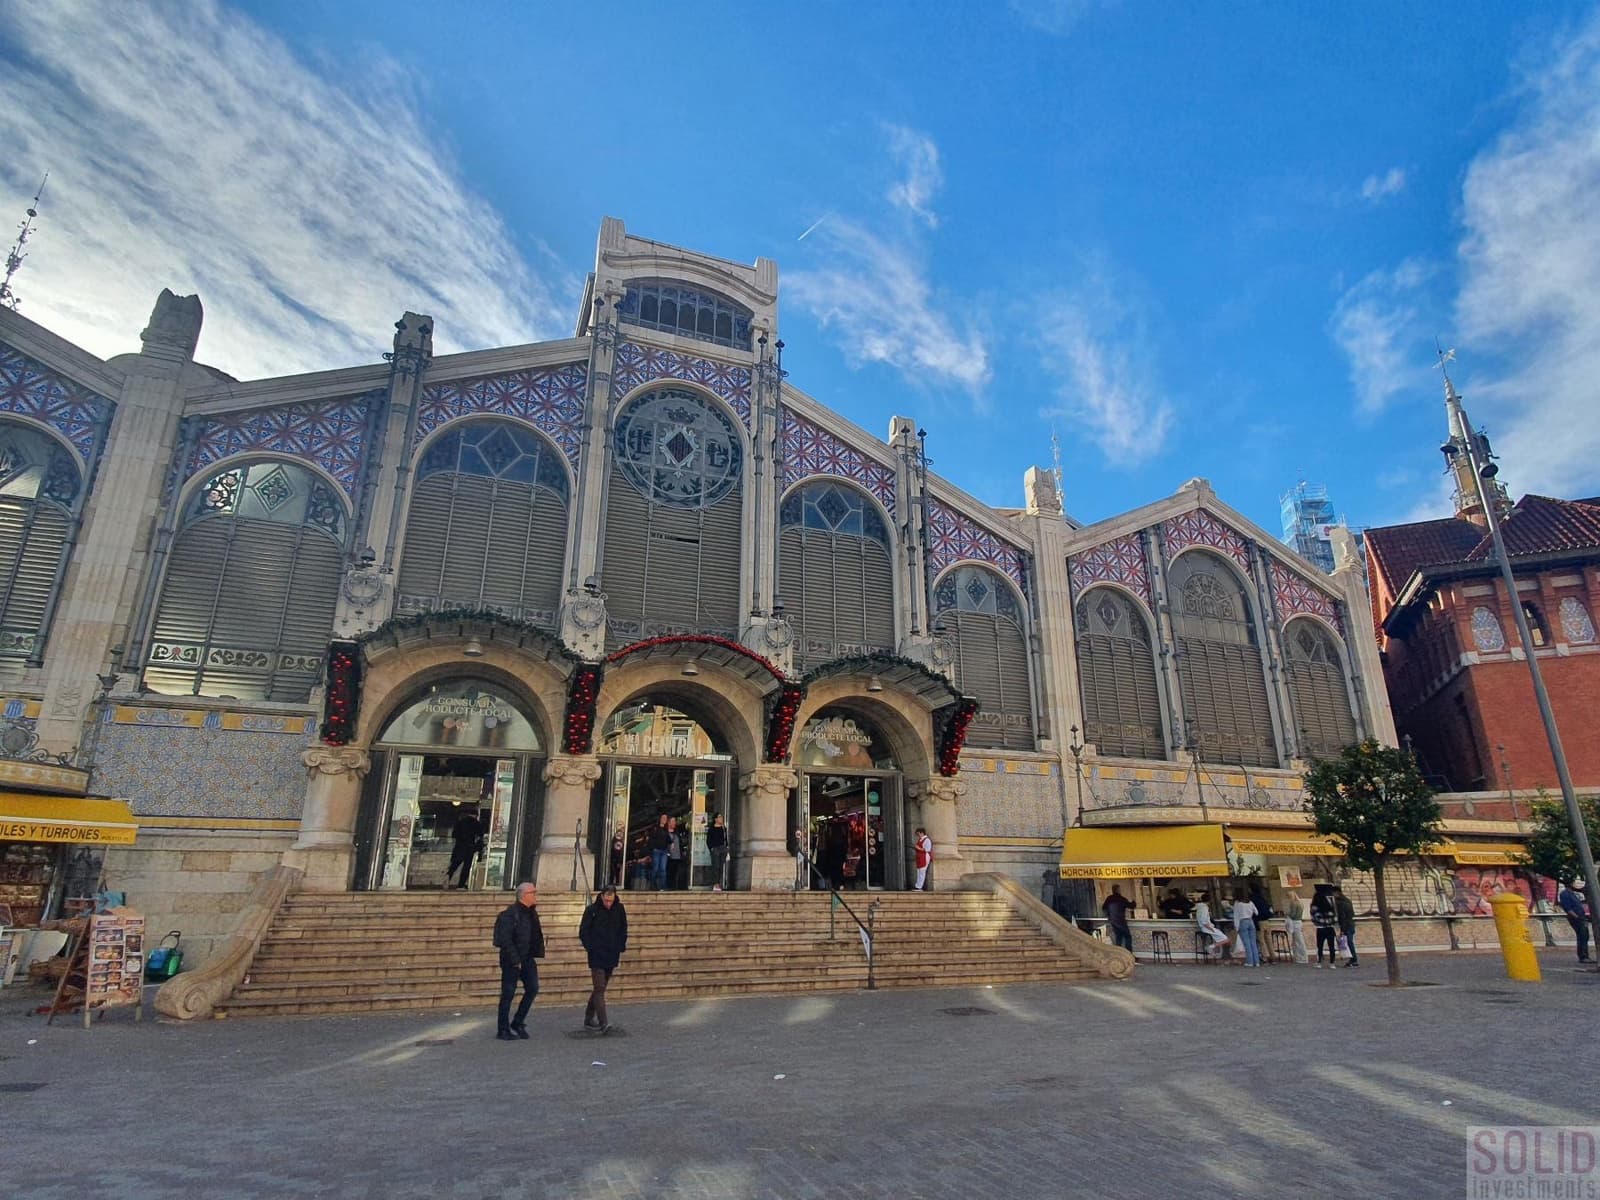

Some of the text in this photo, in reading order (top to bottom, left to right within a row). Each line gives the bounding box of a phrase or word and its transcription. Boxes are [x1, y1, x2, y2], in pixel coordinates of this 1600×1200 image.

[846, 733, 873, 744] LOCAL
[0, 823, 26, 837] ILES
[30, 826, 37, 837] Y
[40, 826, 100, 840] TURRONES
[1061, 866, 1103, 876] HORCHATA
[1105, 866, 1144, 876] CHURROS
[1146, 865, 1197, 875] CHOCOLATE
